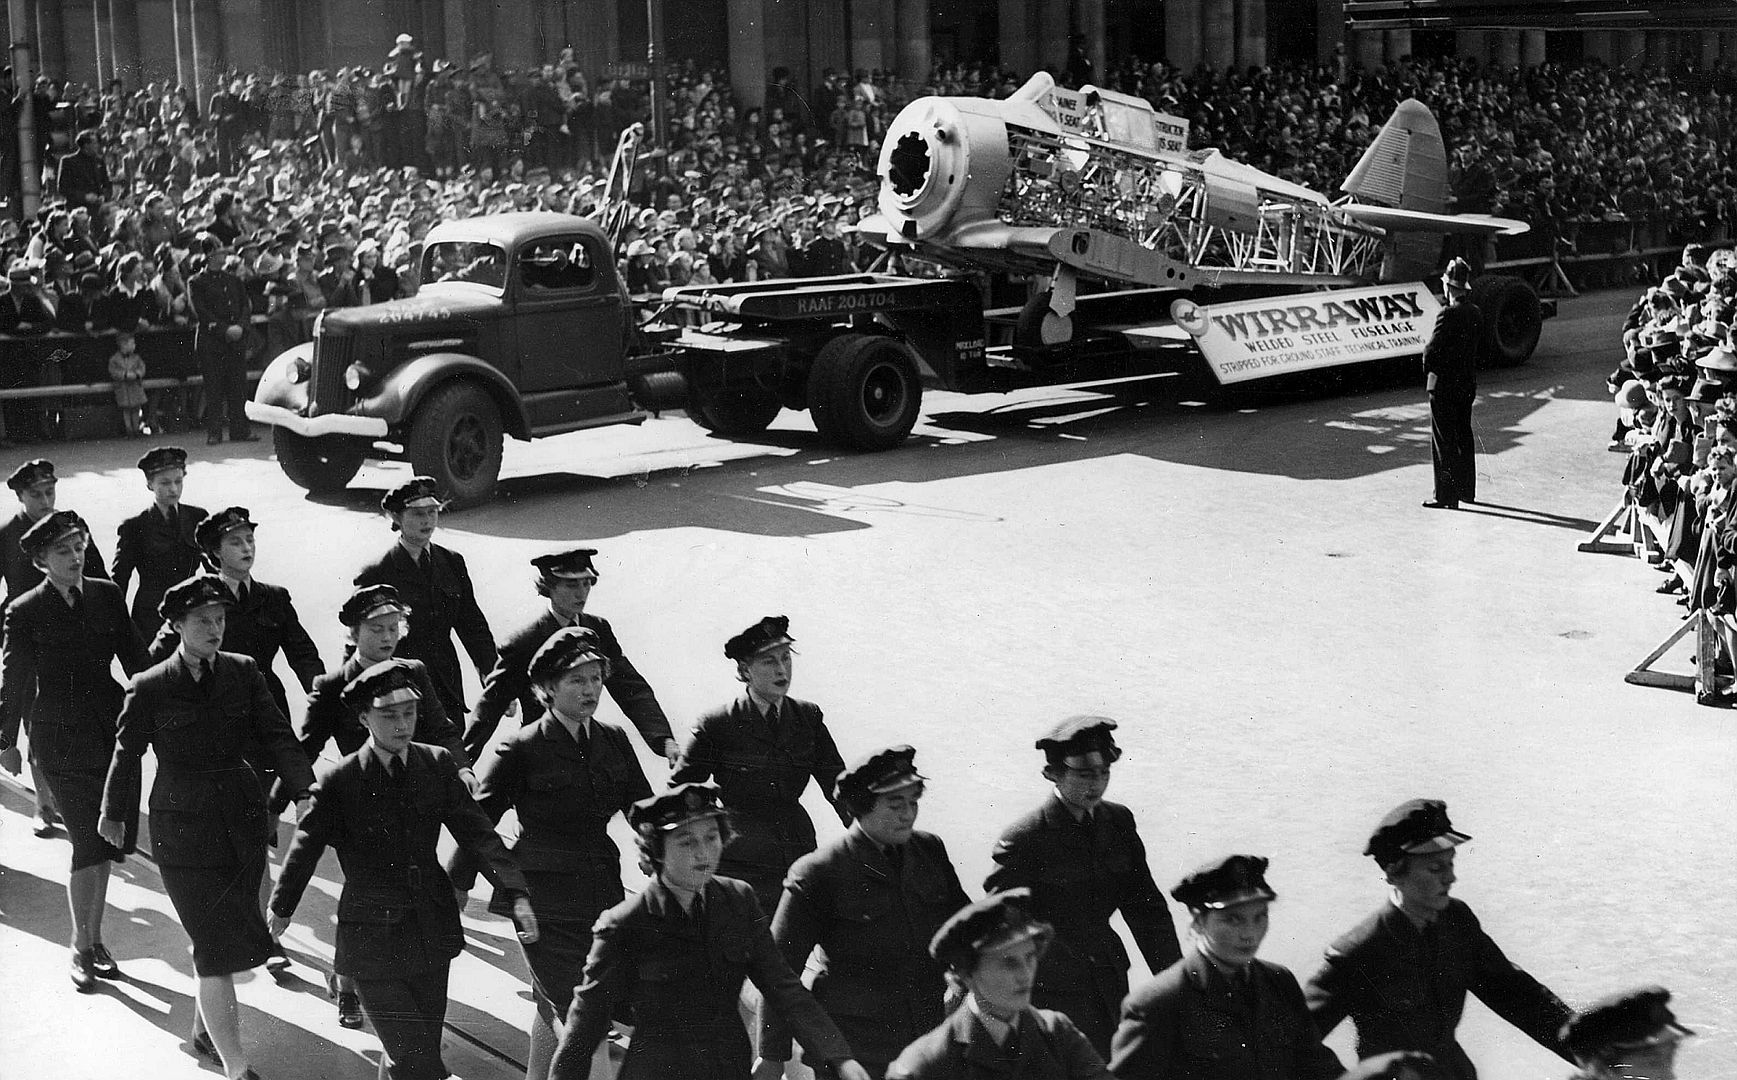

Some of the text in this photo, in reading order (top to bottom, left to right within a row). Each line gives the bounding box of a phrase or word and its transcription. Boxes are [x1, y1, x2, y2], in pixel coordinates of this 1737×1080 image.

[1064, 114, 1081, 128] SEAT
[798, 292, 896, 314] RAAF 204704
[1212, 292, 1424, 341] WIRRAWAY
[1244, 321, 1416, 354] WELDED STEEL FUSELAGE
[1219, 335, 1426, 375] STRIPPED FOR GROUND STAFF TECHNICAL TRAINING
